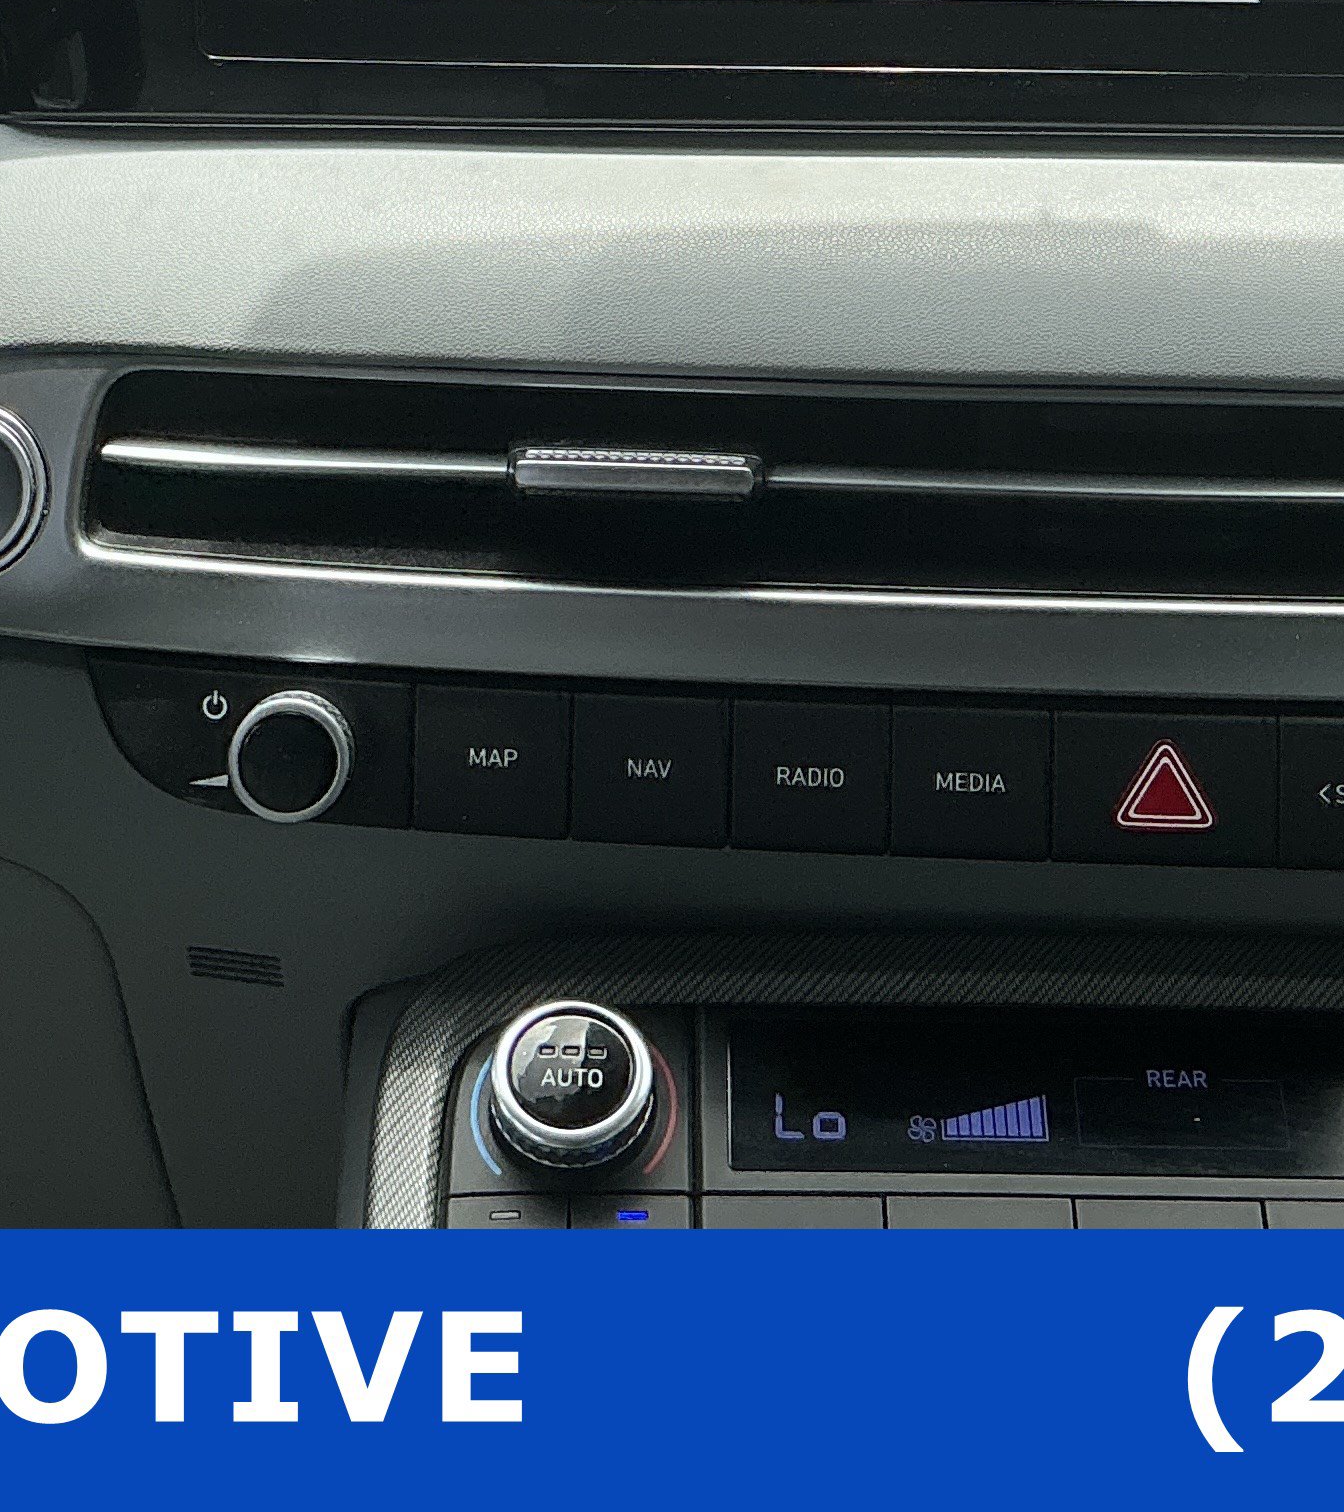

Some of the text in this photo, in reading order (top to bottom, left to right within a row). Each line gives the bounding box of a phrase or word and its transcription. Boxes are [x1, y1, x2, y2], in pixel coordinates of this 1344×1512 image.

[468, 746, 519, 768] MAP
[627, 757, 673, 779] NAV
[776, 766, 845, 789] RADIO
[935, 772, 1007, 794] MEDIA
[540, 1067, 604, 1088] AUTO
[1146, 1068, 1208, 1089] REAR
